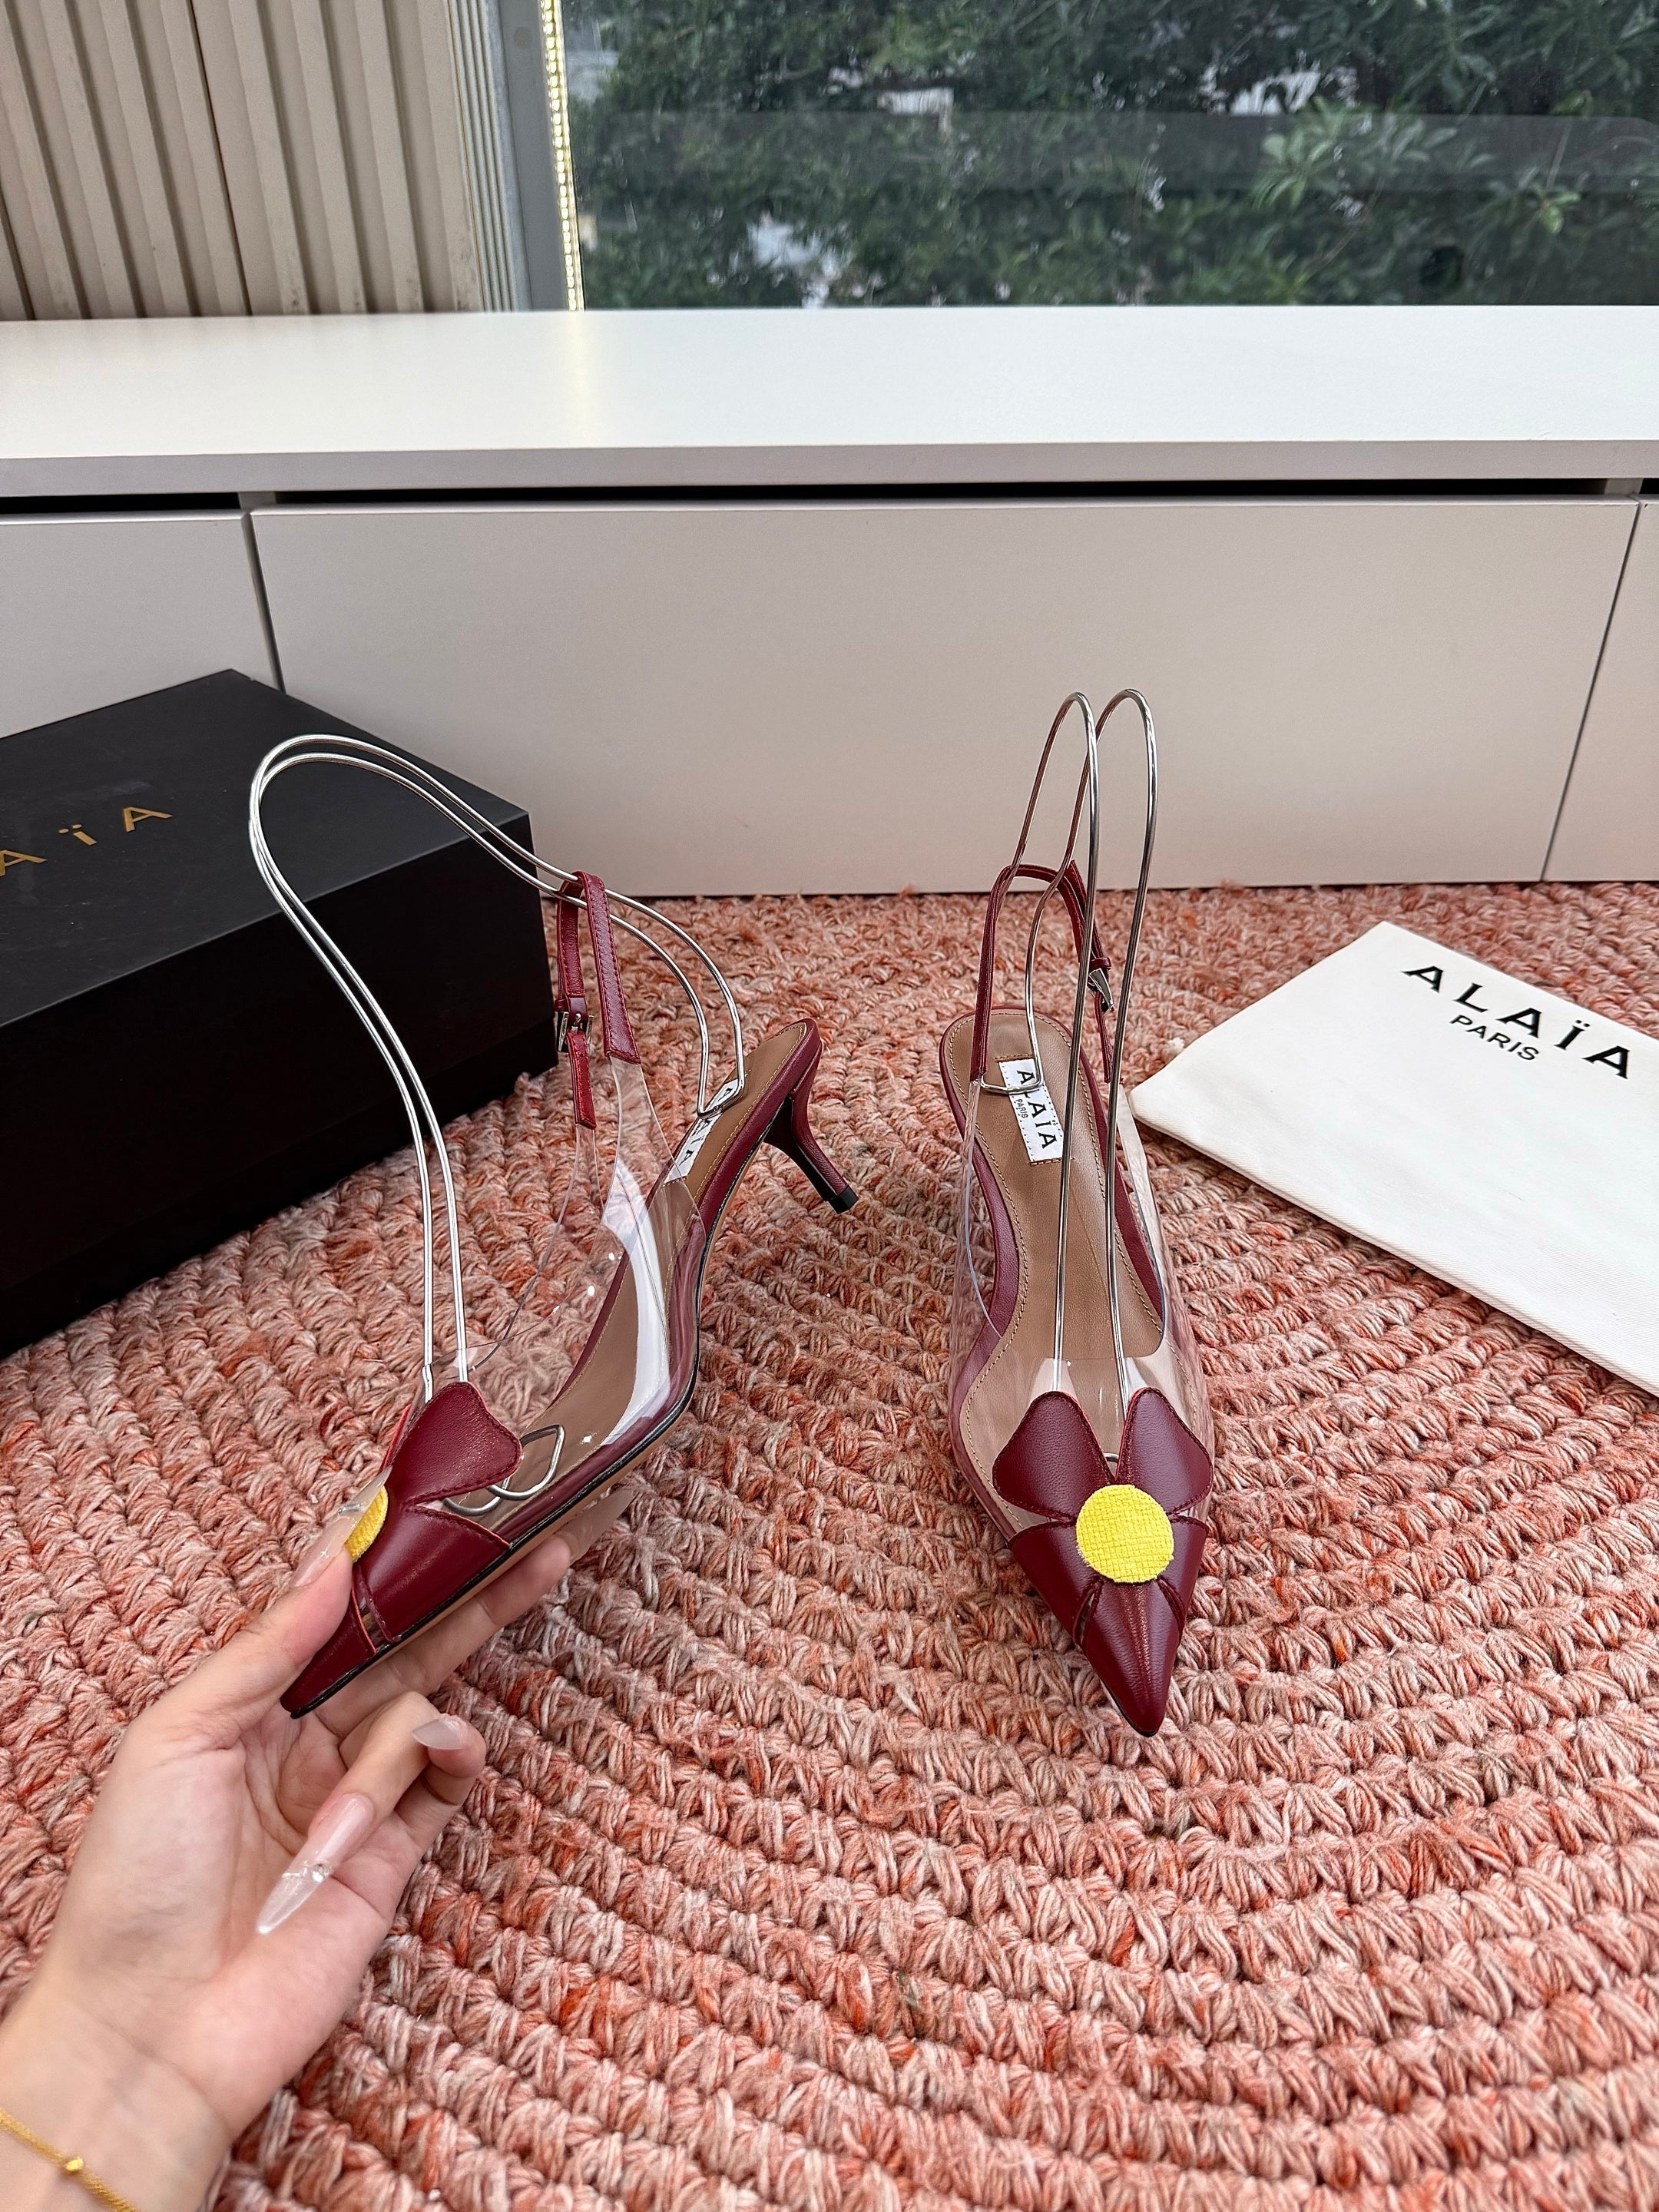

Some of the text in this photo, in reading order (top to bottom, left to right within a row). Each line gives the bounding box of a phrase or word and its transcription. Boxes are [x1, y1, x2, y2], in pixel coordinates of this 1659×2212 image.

[1400, 965, 1631, 1080] ALAÏA
[1449, 1014, 1540, 1061] PARIS
[1015, 1098, 1029, 1119] PARIS
